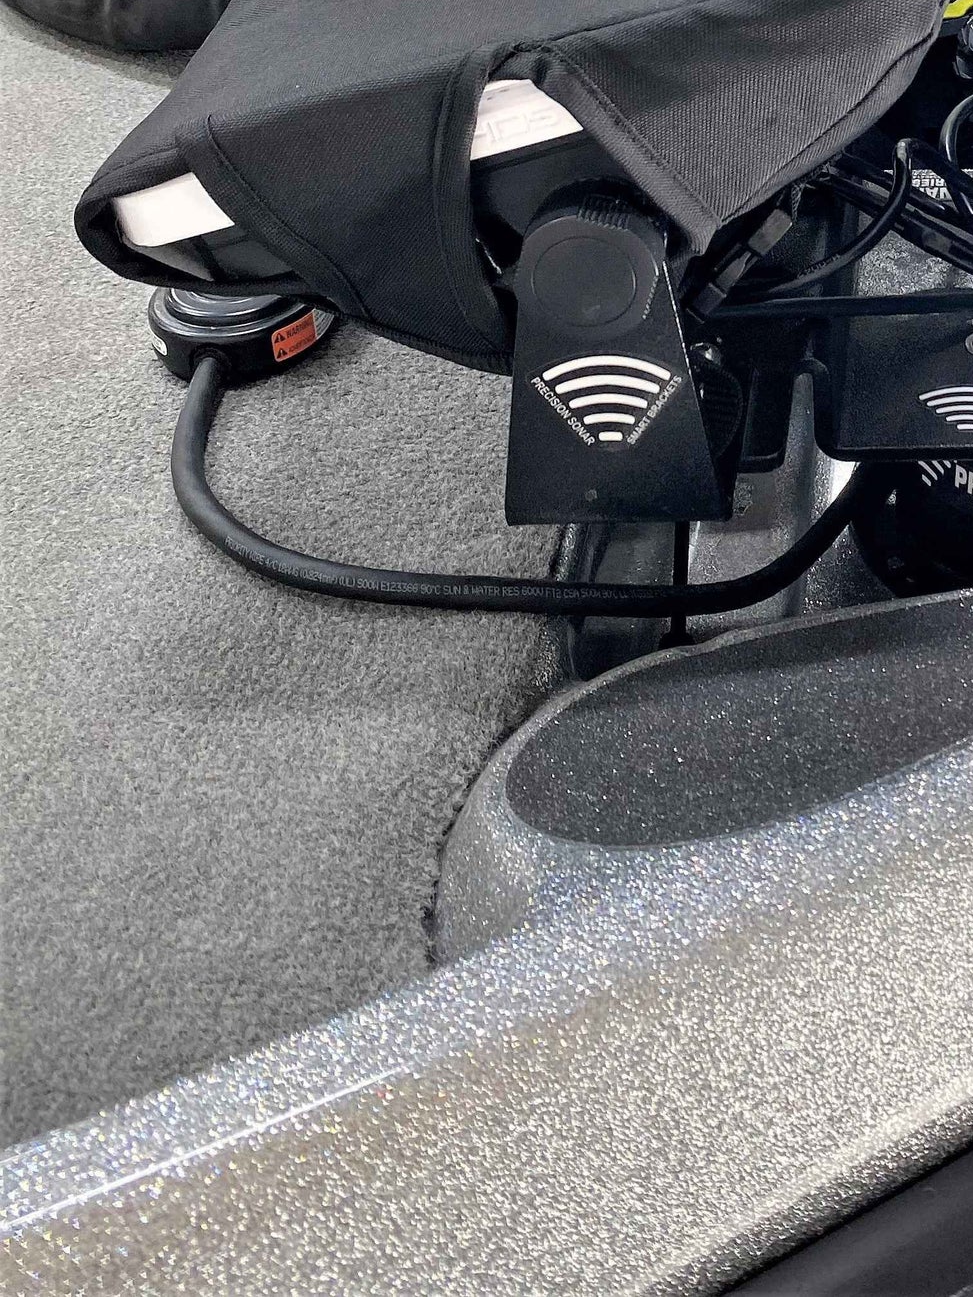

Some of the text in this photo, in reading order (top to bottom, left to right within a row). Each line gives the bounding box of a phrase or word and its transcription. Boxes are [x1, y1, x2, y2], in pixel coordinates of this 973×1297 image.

[530, 376, 596, 447] PRECISION SONAR
[626, 374, 683, 446] SMART BRACKETS
[443, 584, 462, 596] SUN
[463, 585, 470, 595] &
[471, 585, 501, 596] WATER
[502, 586, 520, 598] RES
